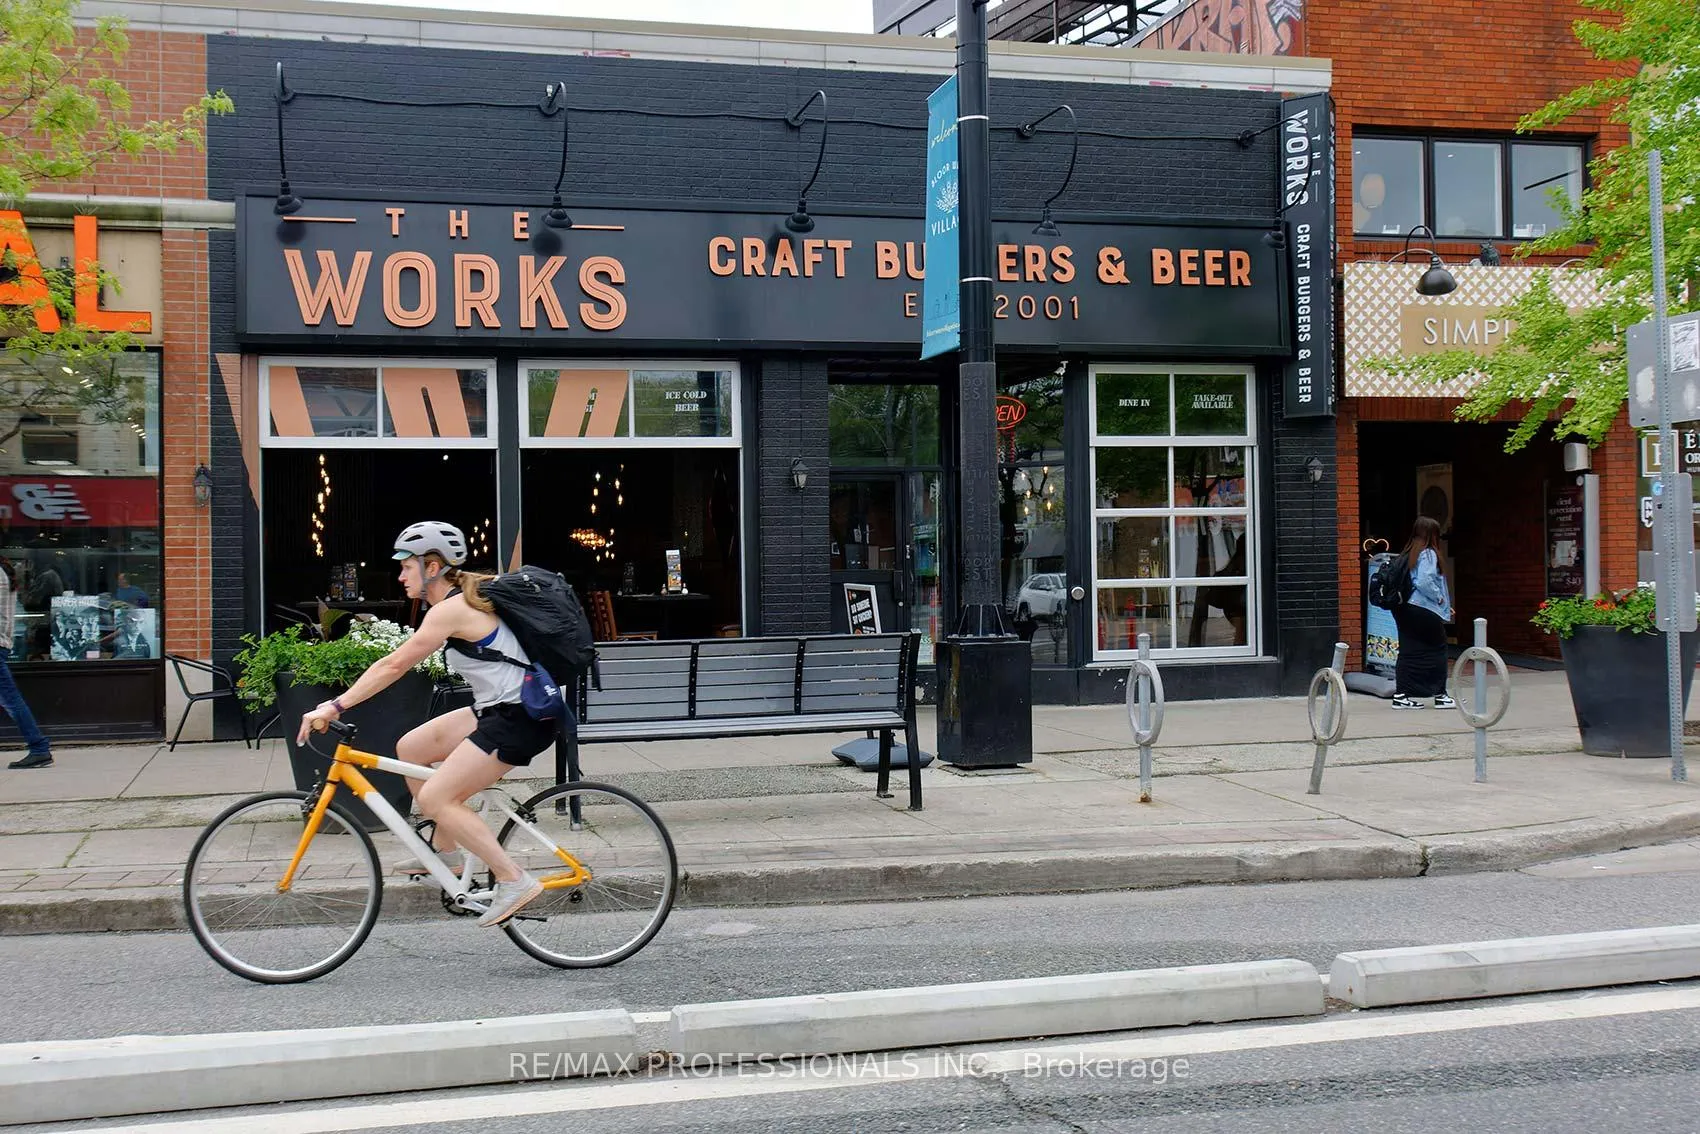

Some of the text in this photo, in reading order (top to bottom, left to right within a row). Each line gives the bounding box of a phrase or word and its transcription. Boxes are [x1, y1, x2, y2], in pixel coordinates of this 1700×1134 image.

[1286, 109, 1309, 206] WORKS
[1311, 134, 1321, 176] THE
[385, 207, 530, 240] THE
[931, 215, 959, 237] VILLA
[708, 236, 1252, 287] CRAFT BUERS & BEER
[283, 248, 628, 331] WORKS
[994, 294, 1080, 320] 2001
[1296, 223, 1312, 404] CRAFT BURGERS & BEER
[665, 391, 707, 400] ICE COLD
[675, 403, 699, 412] BEER
[1118, 398, 1151, 407] DINE IN
[1191, 401, 1234, 409] AVAILABLE
[1193, 394, 1234, 402] TAKE-OUT
